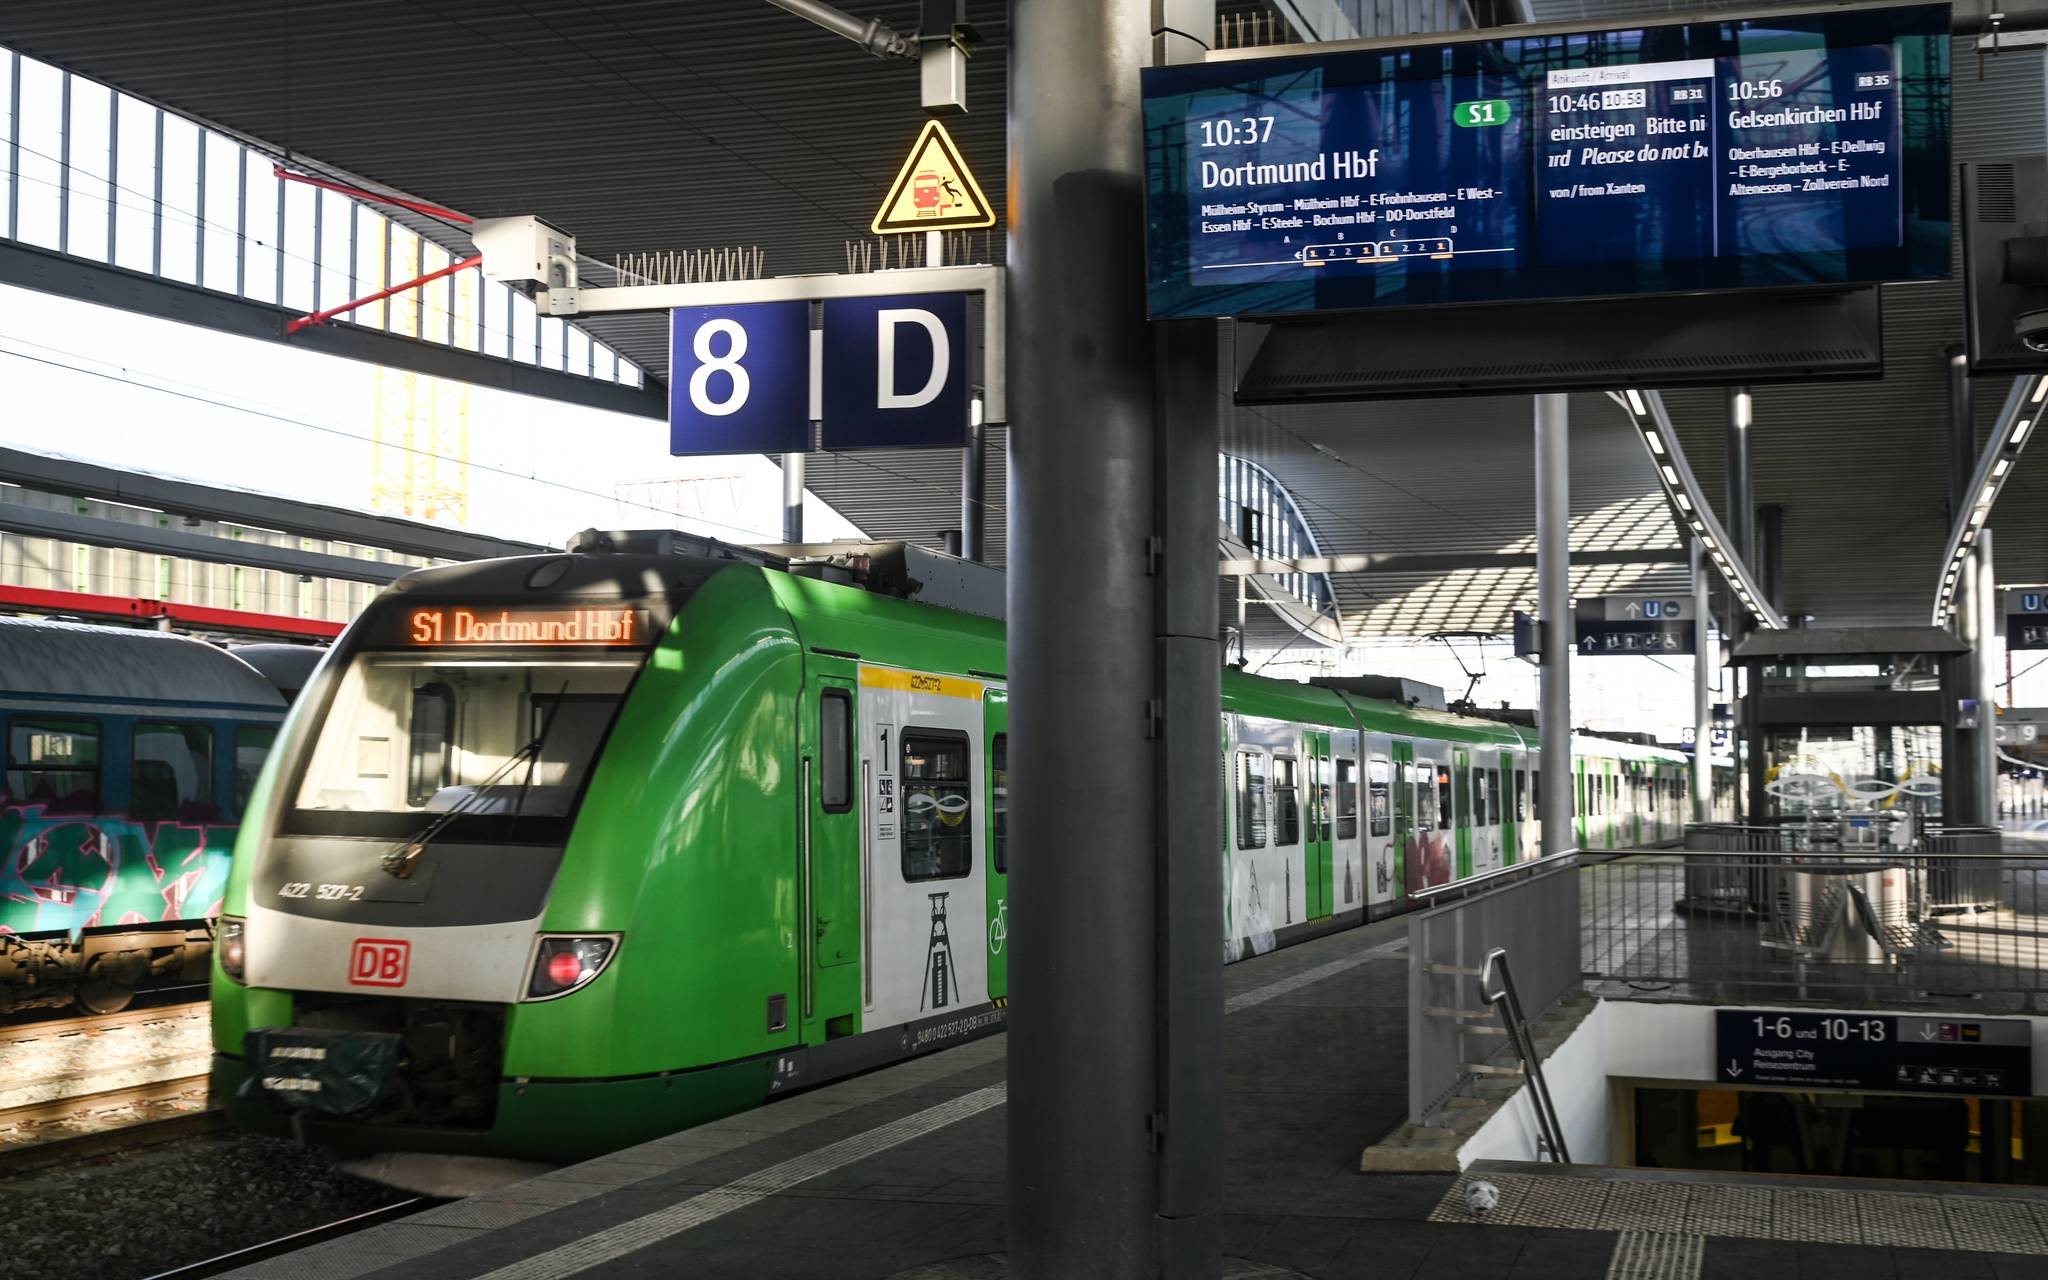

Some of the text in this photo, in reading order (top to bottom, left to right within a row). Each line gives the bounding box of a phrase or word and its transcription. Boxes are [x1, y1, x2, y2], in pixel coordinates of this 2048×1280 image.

[1729, 79, 1782, 100] 10:56
[1874, 75, 1889, 86] 35
[1548, 92, 1642, 113] 10:46 10:58
[1688, 88, 1704, 99] 31
[1469, 104, 1495, 123] S1
[1729, 101, 1883, 129] Gelsenkirchen Hbf
[1200, 116, 1275, 147] 10:37
[1551, 122, 1635, 142] einsteigen
[1646, 117, 1686, 135] Bitte
[1581, 147, 1634, 165] Please
[1637, 144, 1658, 162] do
[1661, 143, 1691, 160] not
[1729, 147, 1797, 160] Oberhausen
[1799, 142, 1821, 156] Hbf
[1831, 140, 1885, 154] E-Dellwig
[1202, 150, 1379, 188] Dortmund Hbf
[1738, 160, 1827, 178] E-Bergeborbeck
[1838, 159, 1850, 171] E-
[1549, 188, 1569, 198] von
[1579, 184, 1604, 197] from
[1606, 182, 1645, 195] Xanten
[1729, 183, 1792, 196] Altenessen
[1802, 177, 1859, 191] Zollverein
[1860, 174, 1889, 187] Nord
[1202, 202, 1284, 216] Mülheim-Styrum
[1294, 197, 1339, 210] Mülheim
[1340, 195, 1360, 208] Hbf
[1370, 192, 1447, 206] E-Frohnhausen
[1457, 188, 1465, 200] E
[1466, 187, 1493, 200] West
[1202, 221, 1231, 233] Essen
[1232, 218, 1252, 231] Hbf
[1262, 216, 1303, 229] E-Steele
[1313, 213, 1354, 226] Bochum
[1356, 211, 1376, 223] Hbf
[1386, 206, 1455, 221] DO-Dorstfeld
[1284, 225, 1458, 243] A B C D
[1328, 249, 1336, 257] 2
[1344, 247, 1352, 255] 2
[1362, 246, 1371, 254] 1
[1383, 245, 1392, 253] 1
[1402, 244, 1410, 252] 2
[1418, 243, 1427, 251] 2
[689, 319, 750, 416] 8
[877, 308, 950, 409] D
[1646, 602, 1659, 618] U
[2024, 595, 2039, 610] U
[413, 609, 633, 642] S1 Dortmund Hbf
[2023, 725, 2036, 741] 9
[880, 728, 889, 772] 1
[277, 882, 365, 901] 422 527-2
[356, 944, 402, 981] DB
[1753, 1016, 1886, 1041] 1-6 und 10-13
[1753, 1048, 1815, 1060] Ausgang City
